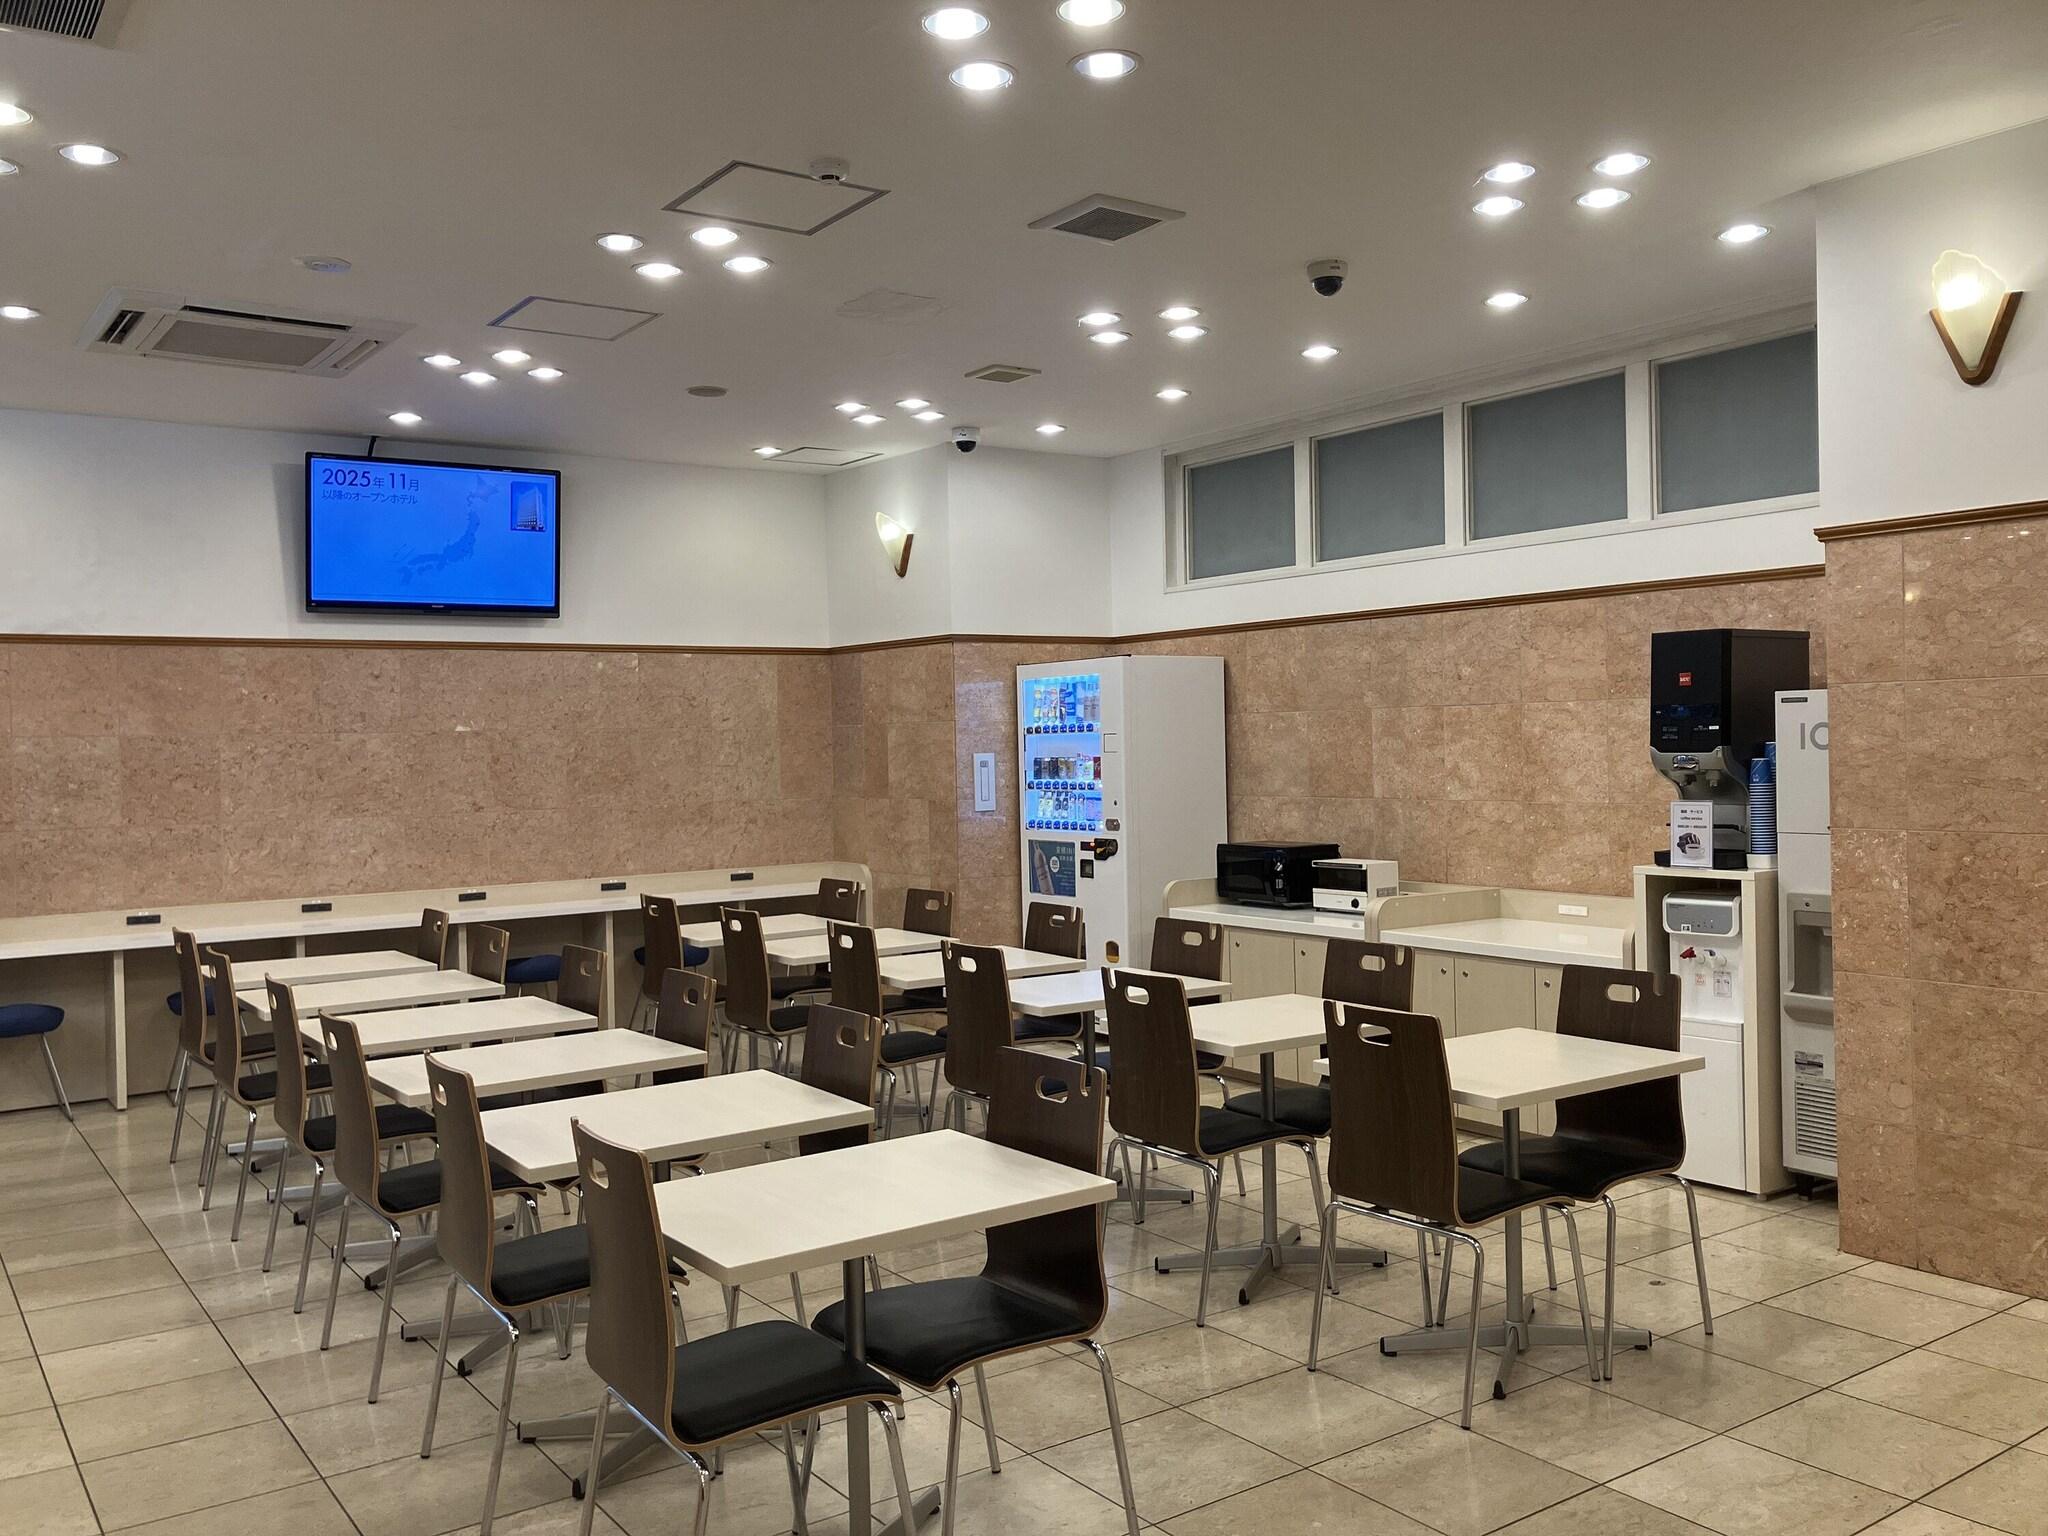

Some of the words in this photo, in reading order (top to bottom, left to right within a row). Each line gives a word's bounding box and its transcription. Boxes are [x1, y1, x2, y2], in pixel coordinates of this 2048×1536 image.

[322, 467, 384, 489] 2025年
[389, 472, 418, 491] 11月
[321, 489, 418, 504] 以降のオープンホテル
